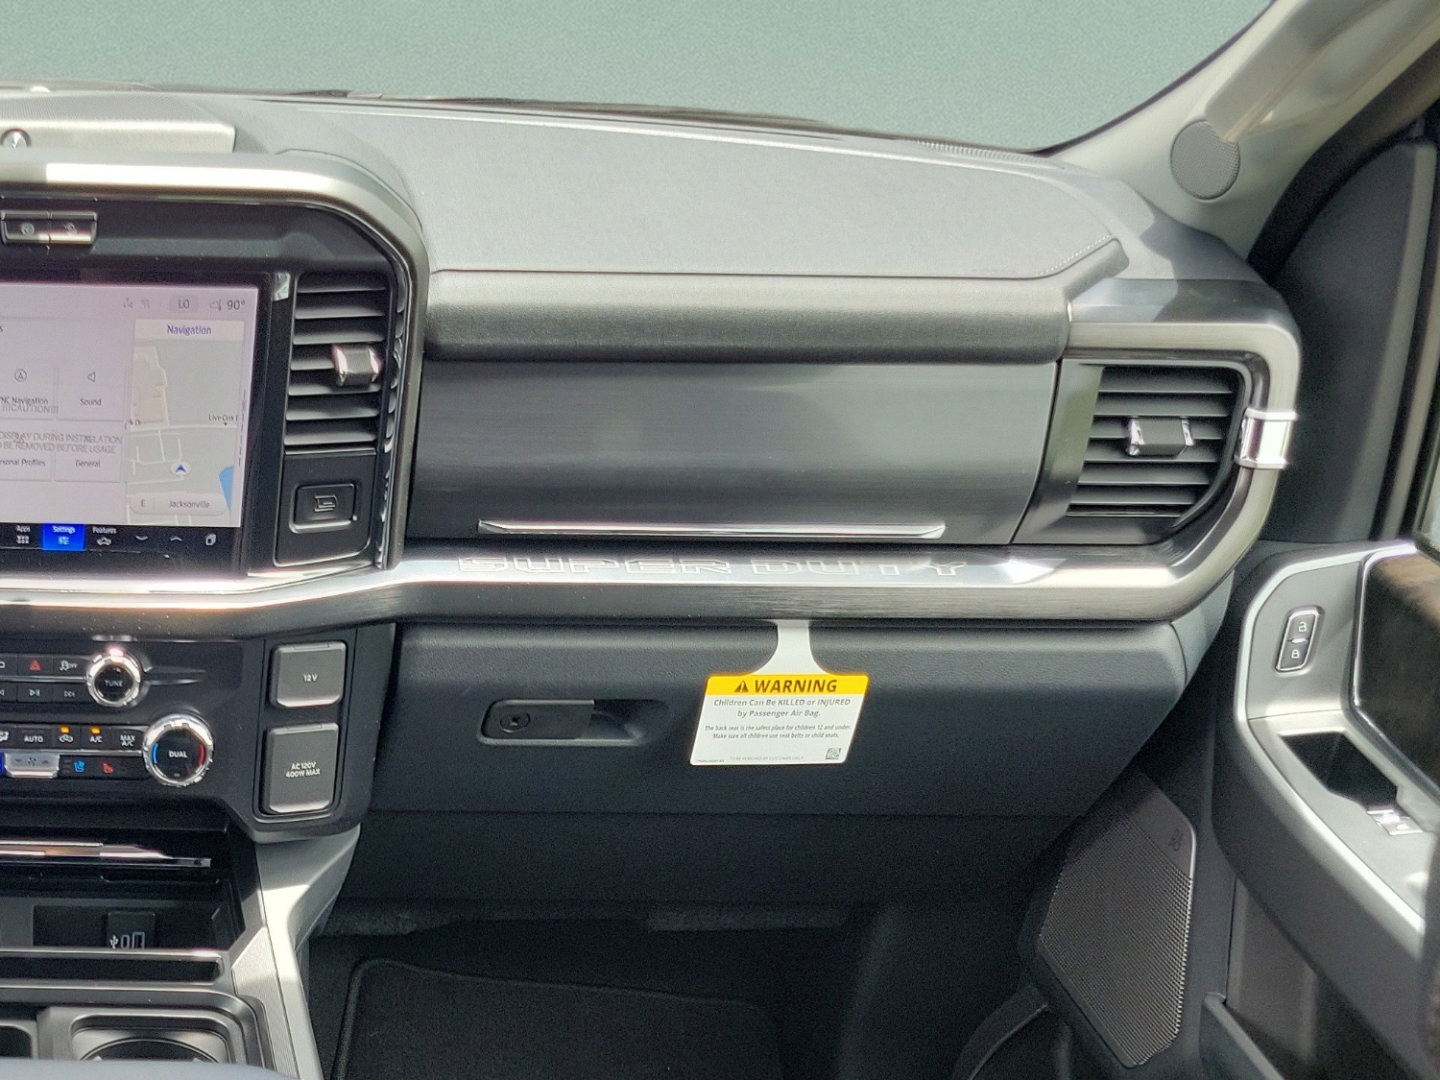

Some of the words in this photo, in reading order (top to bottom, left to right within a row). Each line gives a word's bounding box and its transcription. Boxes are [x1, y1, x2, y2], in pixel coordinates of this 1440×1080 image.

[178, 299, 190, 309] LO
[226, 299, 246, 310] 90°
[166, 325, 212, 336] Navigation
[11, 395, 49, 406] Navigation
[79, 397, 102, 406] Sound
[33, 432, 64, 442] DURING
[15, 441, 56, 452] REMOVED
[56, 443, 88, 453] BEFORE
[89, 445, 117, 454] USAGE
[21, 458, 46, 468] Profiles
[75, 459, 101, 468] General
[168, 500, 211, 509] Jacksonville
[16, 525, 31, 533] Apps
[52, 526, 76, 534] Settings
[458, 556, 732, 575] SUPER
[104, 679, 124, 688] TUNE
[754, 679, 838, 693] WARNING
[713, 698, 747, 706] Children
[817, 699, 851, 707] INJURED
[737, 710, 747, 719] by
[749, 710, 789, 719] Passenger
[790, 709, 803, 717] Air
[804, 709, 821, 718] Bag.
[771, 724, 785, 732] place
[24, 735, 44, 743] AUTO
[89, 735, 102, 743] A/C
[168, 751, 188, 759] DUAL
[285, 769, 305, 778] 400W
[306, 768, 321, 776] MAX
